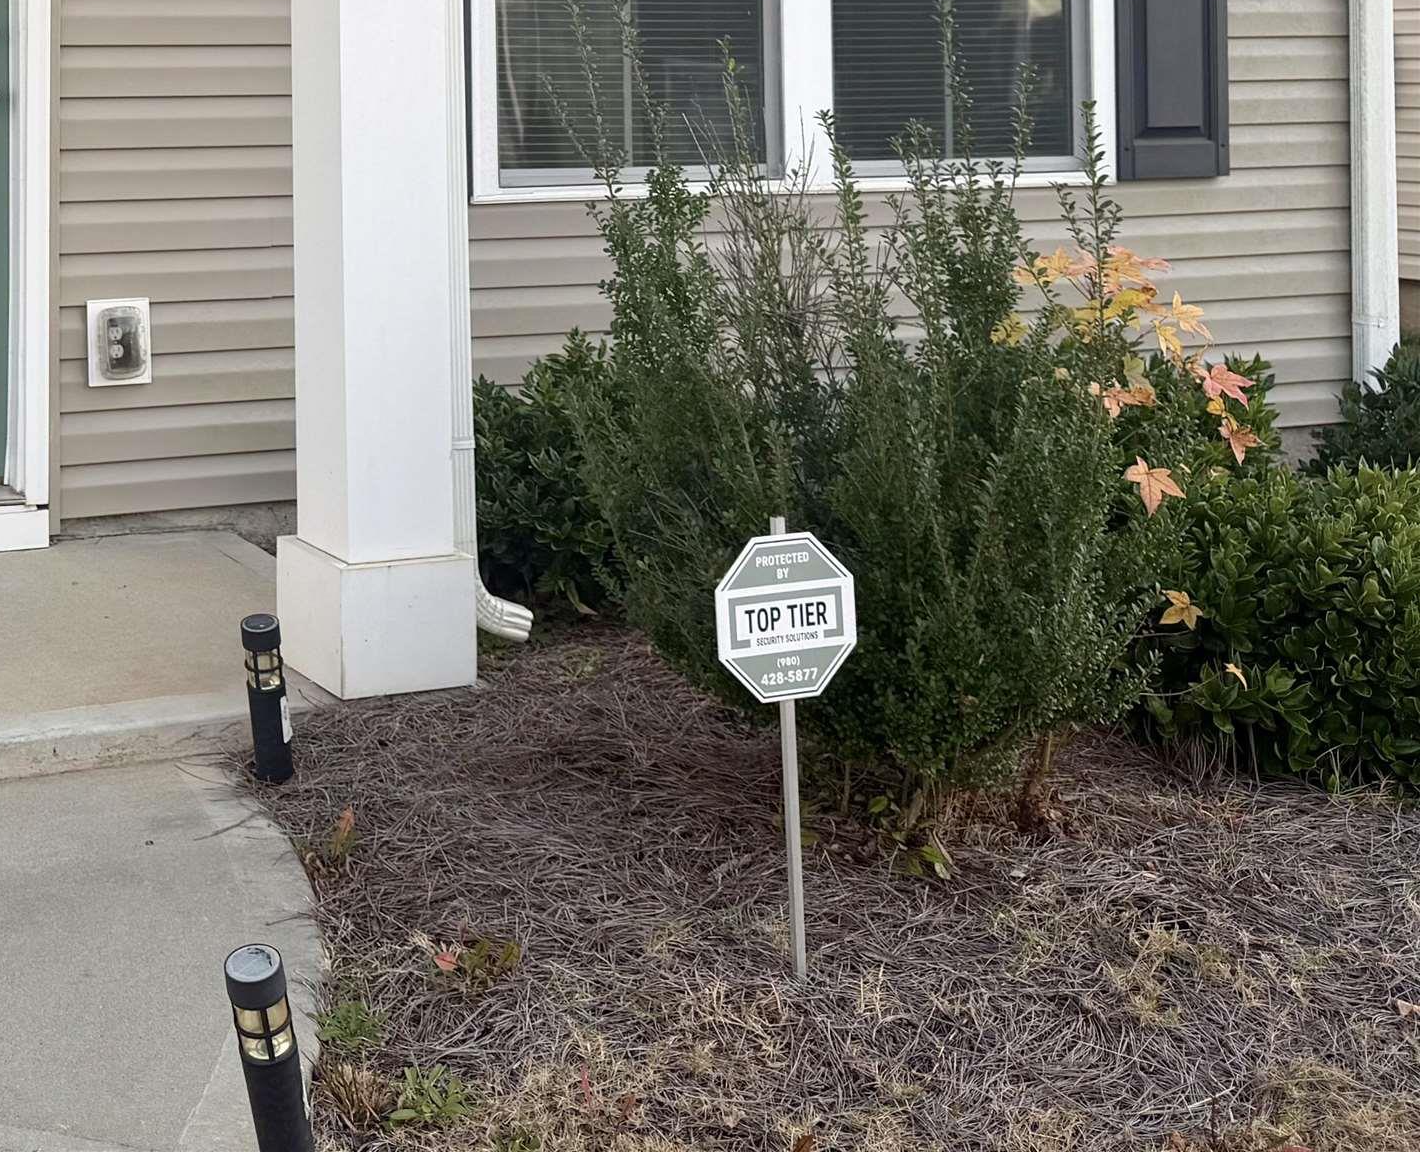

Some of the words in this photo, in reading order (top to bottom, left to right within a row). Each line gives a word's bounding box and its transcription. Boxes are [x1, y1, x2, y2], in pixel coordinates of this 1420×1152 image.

[755, 551, 809, 568] PROTECTED
[776, 567, 789, 579] BY
[744, 606, 781, 634] TOP
[787, 601, 828, 629] TIER
[756, 633, 784, 647] SECURITY
[785, 630, 819, 644] SOLUTIONS
[777, 656, 800, 668] (980)
[761, 667, 818, 686] 428-5877
